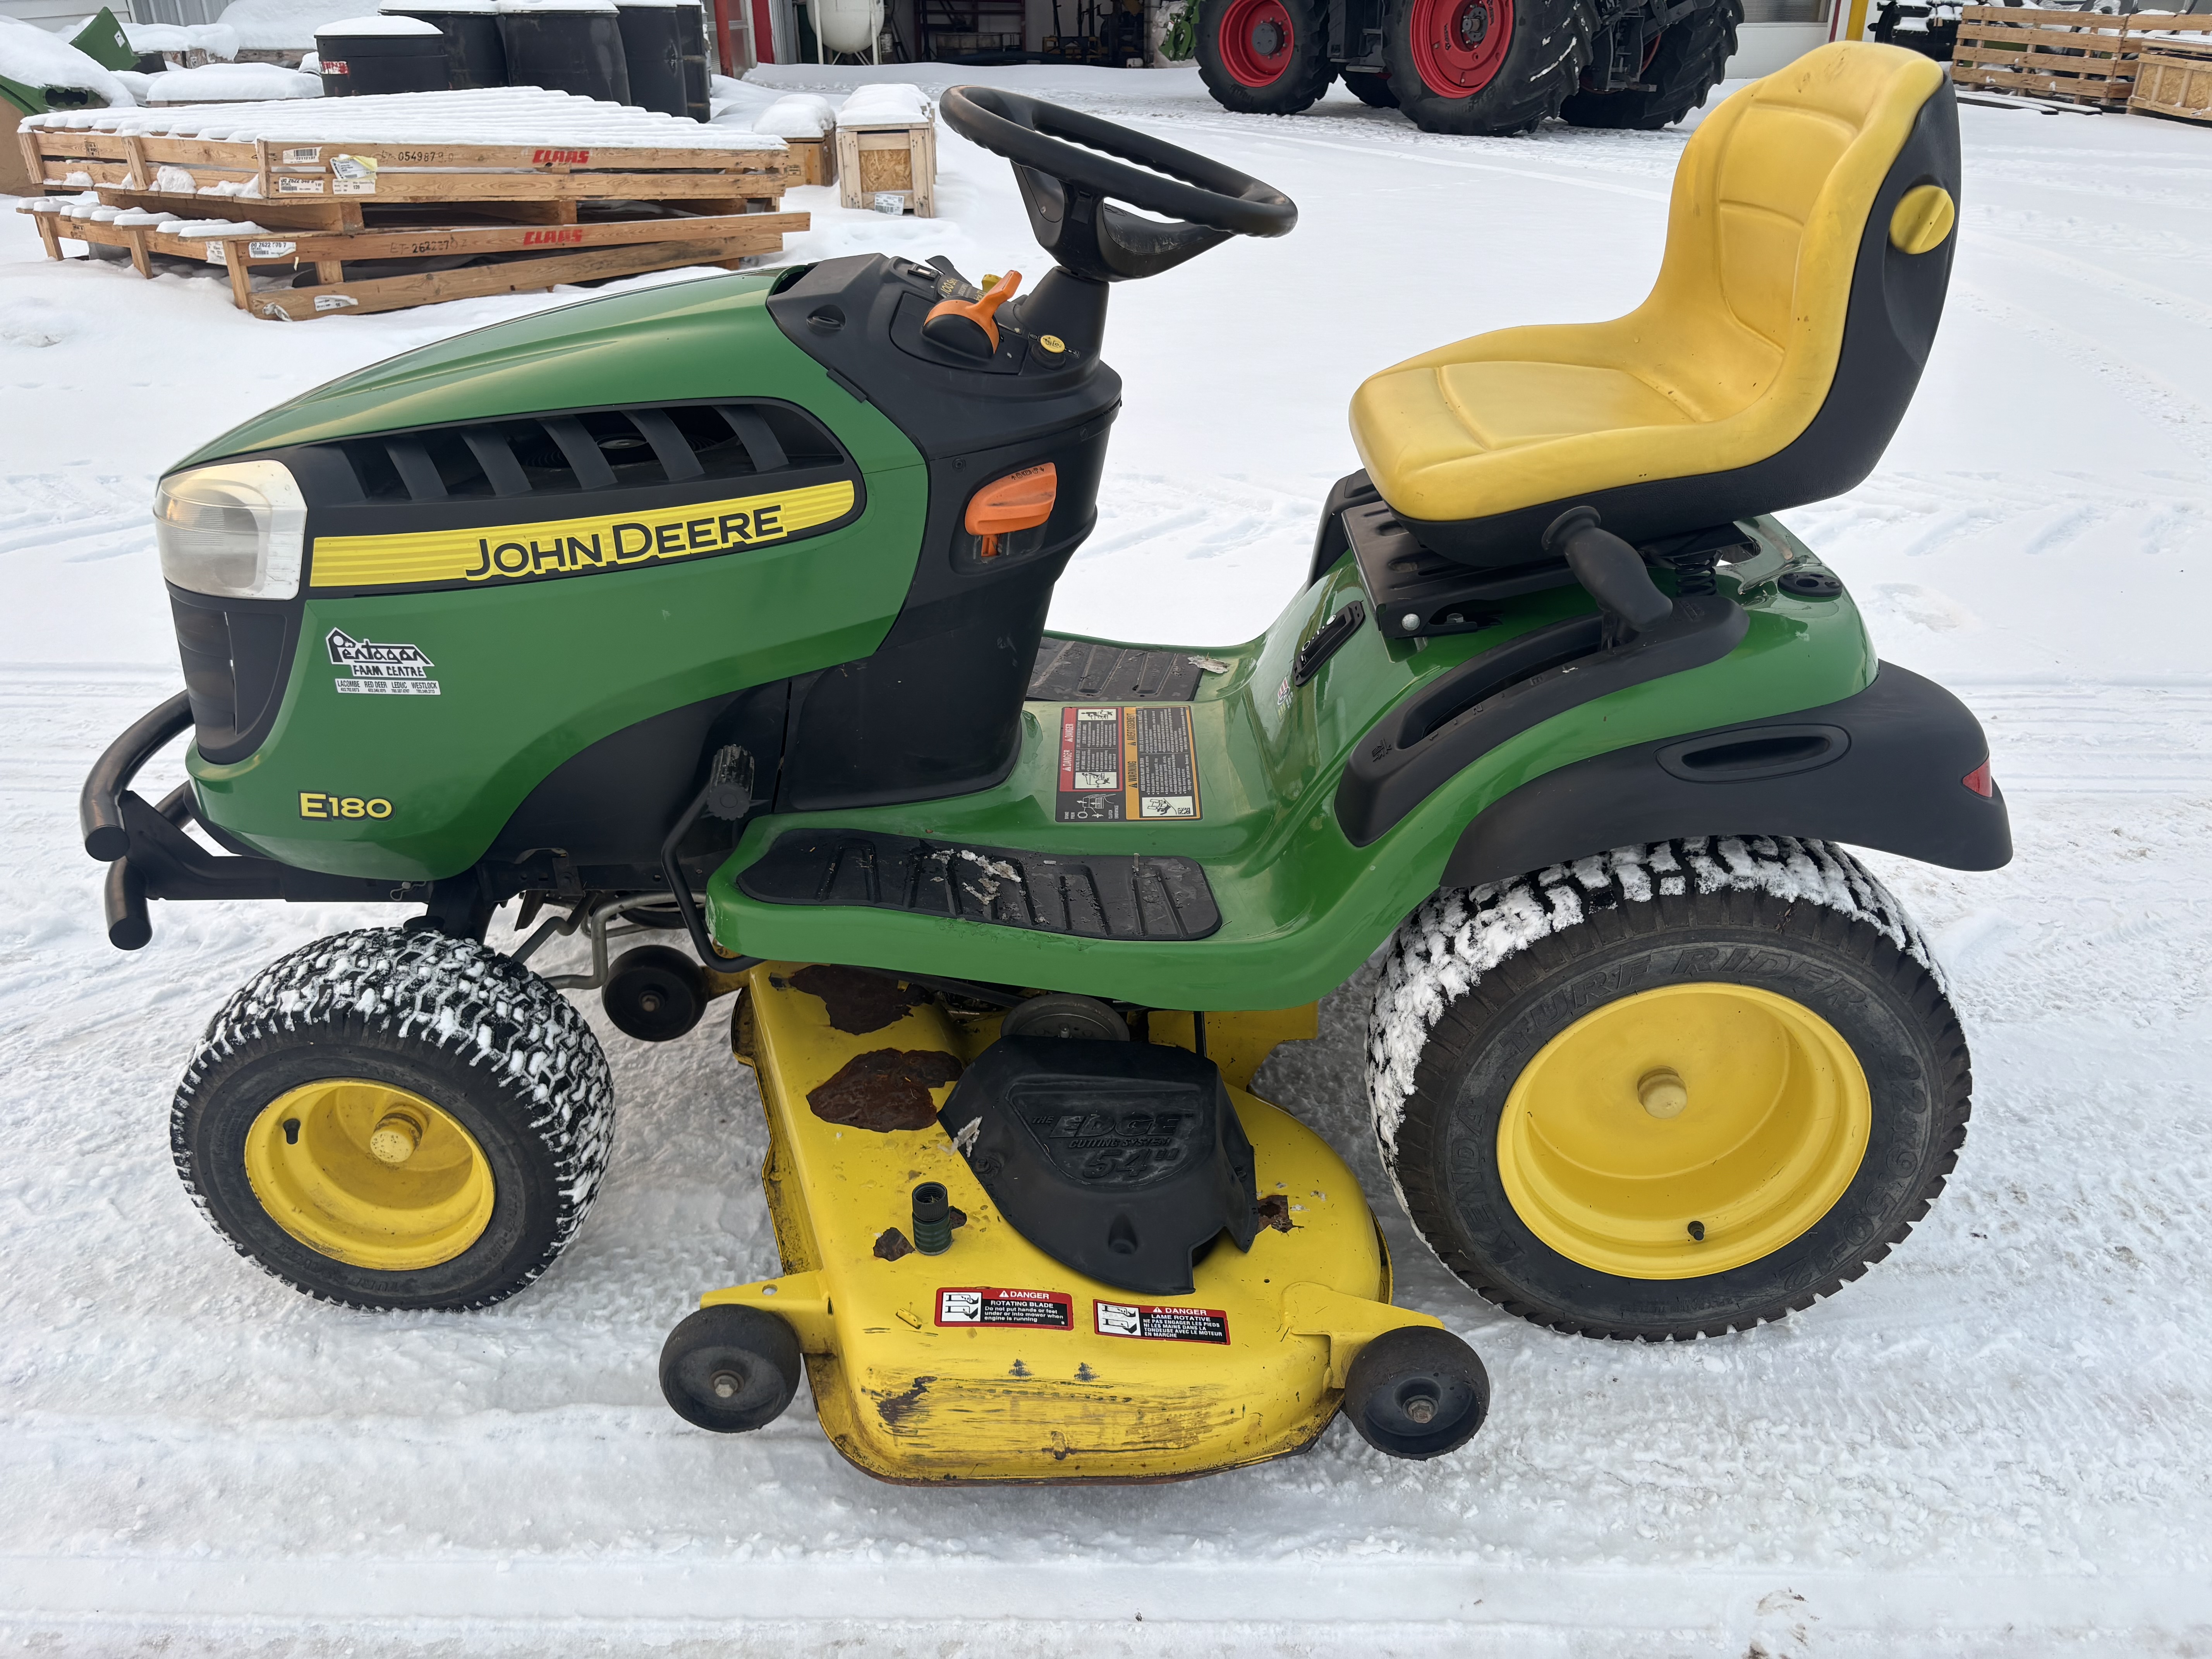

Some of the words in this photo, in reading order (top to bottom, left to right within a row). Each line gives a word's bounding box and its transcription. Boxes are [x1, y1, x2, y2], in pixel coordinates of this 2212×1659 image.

[532, 149, 589, 163] CLAAS
[524, 229, 582, 246] CLAAS
[466, 534, 603, 577] JOHN
[612, 505, 783, 560] DEERE
[386, 666, 424, 676] CENTRE
[1065, 724, 1073, 738] DANGER
[1063, 750, 1072, 766] DANGER
[1128, 761, 1137, 781] WARNING
[300, 793, 392, 818] E180
[1498, 953, 1653, 1054] TURF
[1671, 945, 1869, 1010] RIDER
[1049, 1114, 1182, 1138] EDGE
[1069, 1139, 1119, 1148] CUTTING
[1121, 1137, 1170, 1147] SYSTEM
[1450, 1099, 1525, 1265] KENDA
